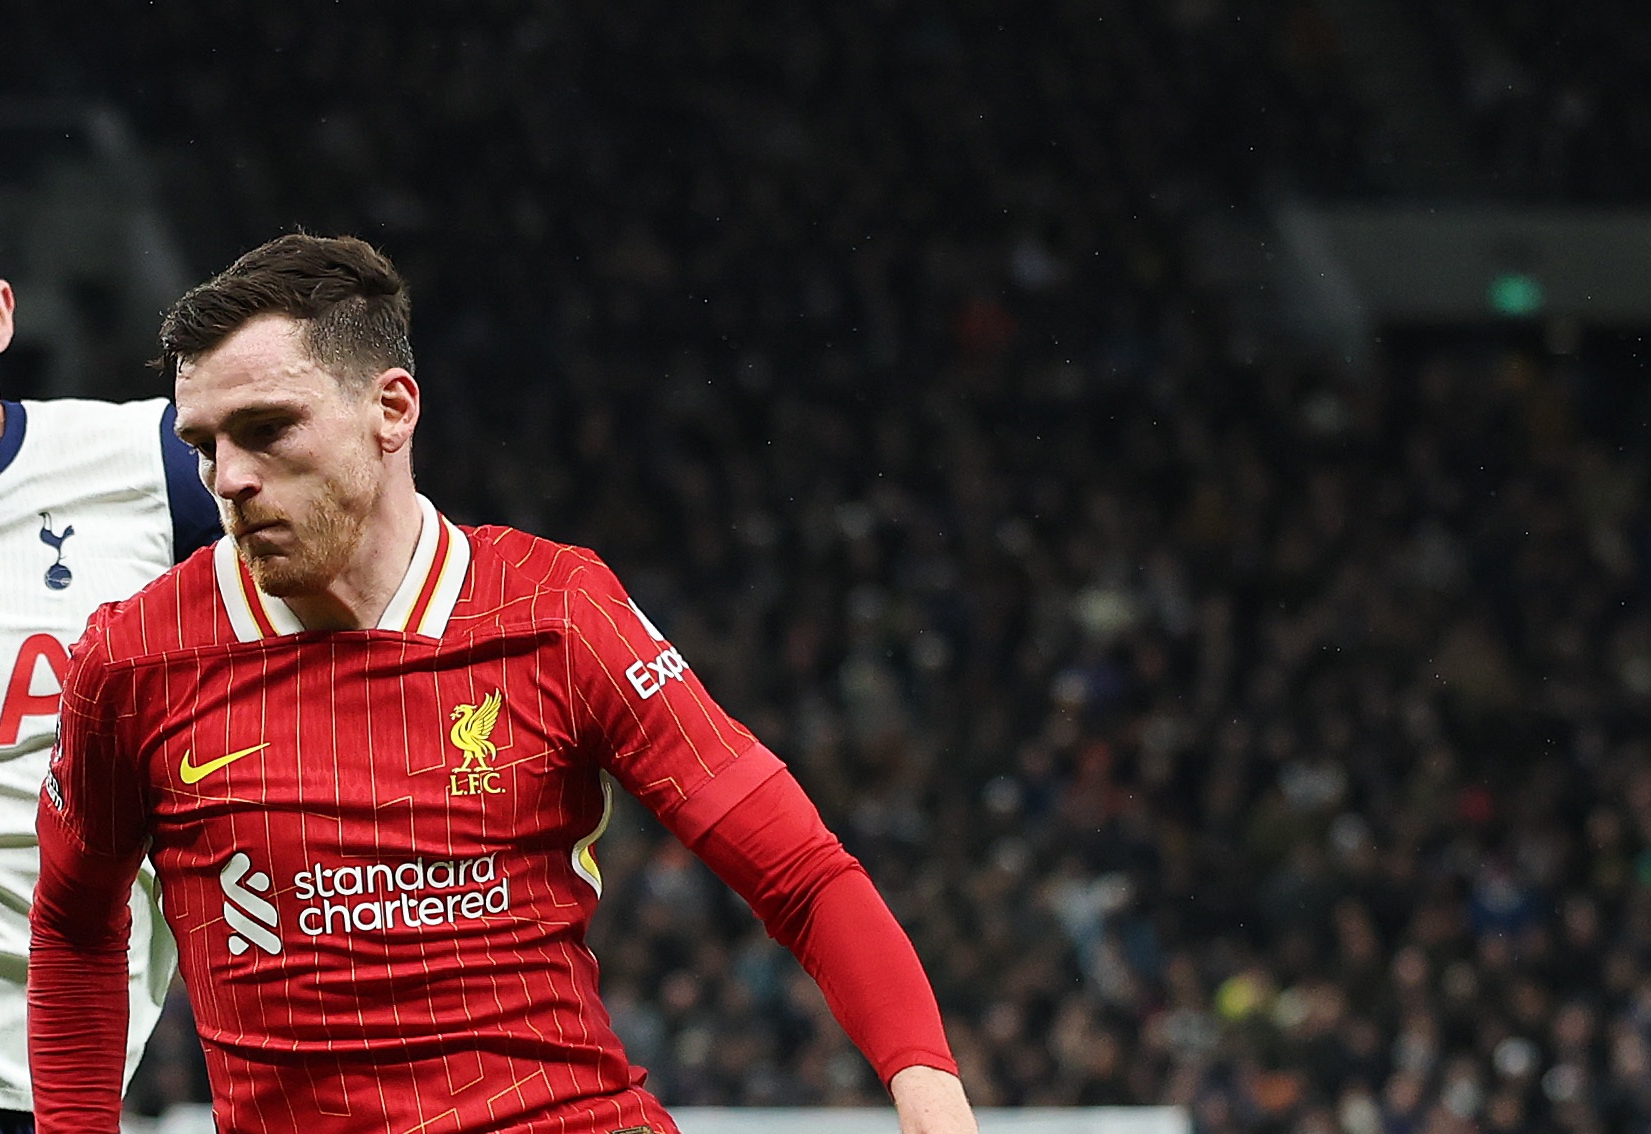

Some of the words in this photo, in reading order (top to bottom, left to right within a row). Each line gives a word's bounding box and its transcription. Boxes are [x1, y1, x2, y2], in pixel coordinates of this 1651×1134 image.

[449, 772, 506, 796] L.F.C.
[294, 852, 497, 899] standard
[298, 877, 509, 936] chartered
